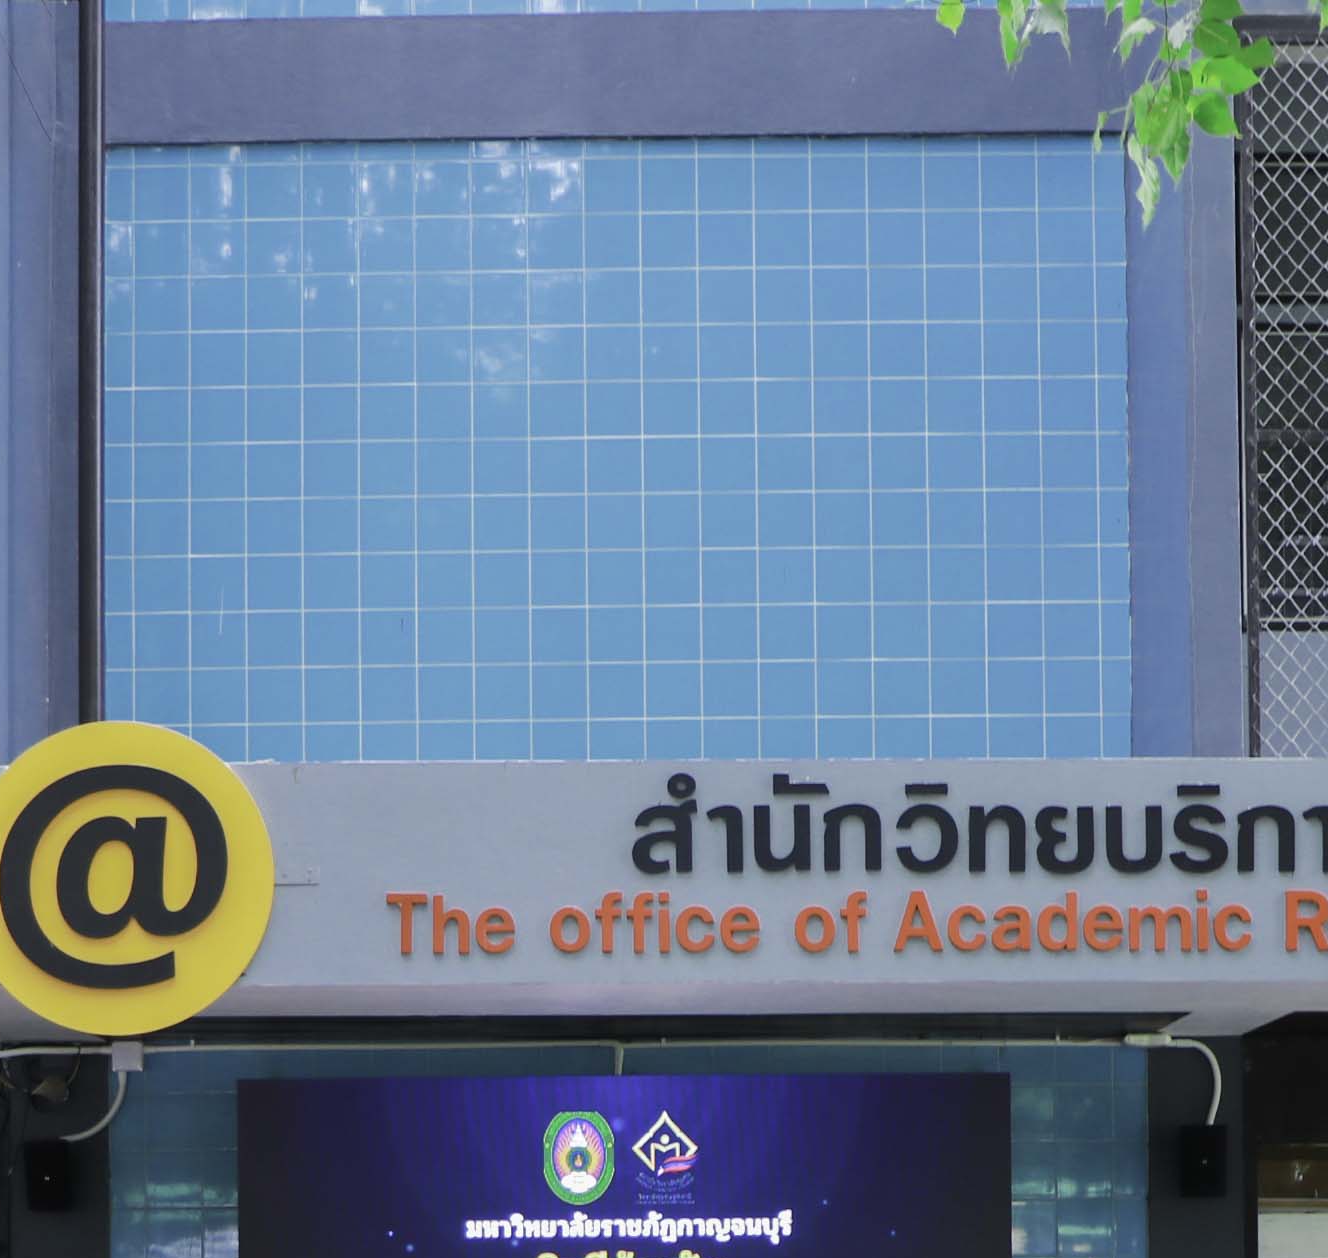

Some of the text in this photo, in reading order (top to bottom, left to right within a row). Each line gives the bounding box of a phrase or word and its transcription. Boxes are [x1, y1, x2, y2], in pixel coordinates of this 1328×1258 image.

[387, 893, 514, 954] The
[551, 892, 760, 953] office
[795, 890, 867, 953] of
[894, 889, 1252, 953] Academic
